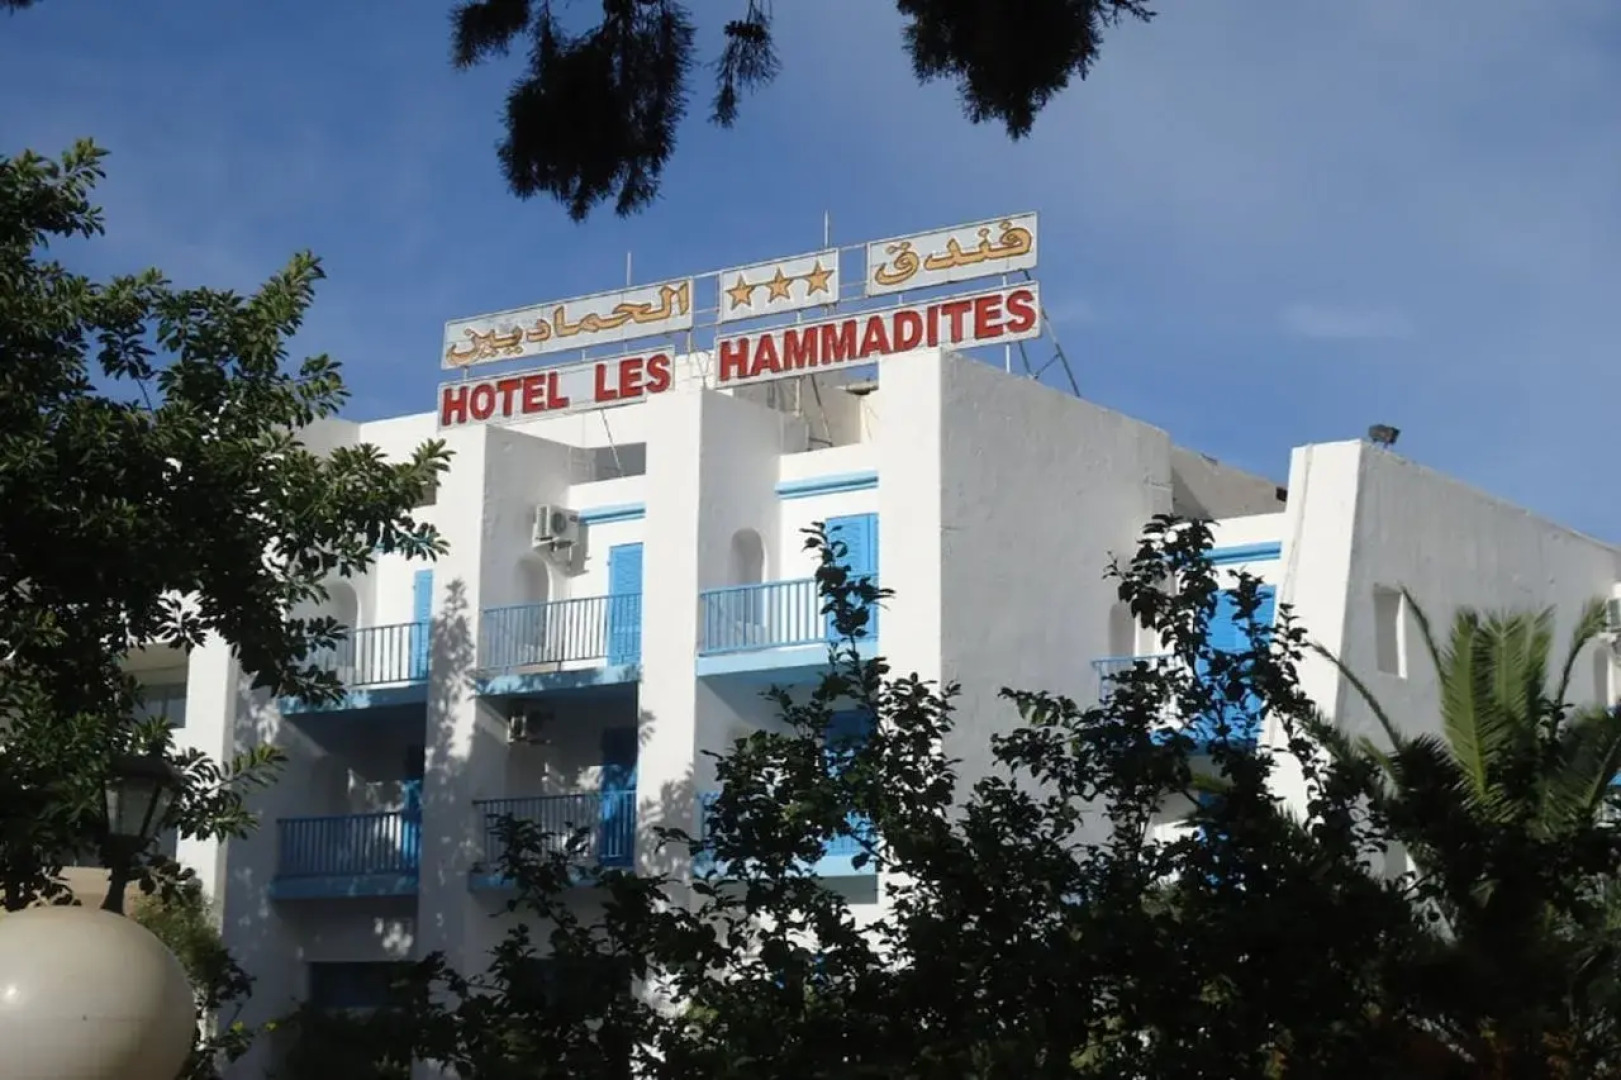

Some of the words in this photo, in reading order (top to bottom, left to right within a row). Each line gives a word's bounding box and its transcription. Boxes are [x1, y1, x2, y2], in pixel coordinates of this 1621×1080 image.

[874, 219, 1033, 286] فندق
[442, 371, 570, 426] HOTEL
[595, 353, 672, 403] LES
[719, 289, 1037, 382] HAMMADITES
[446, 279, 690, 366] الحماديين
